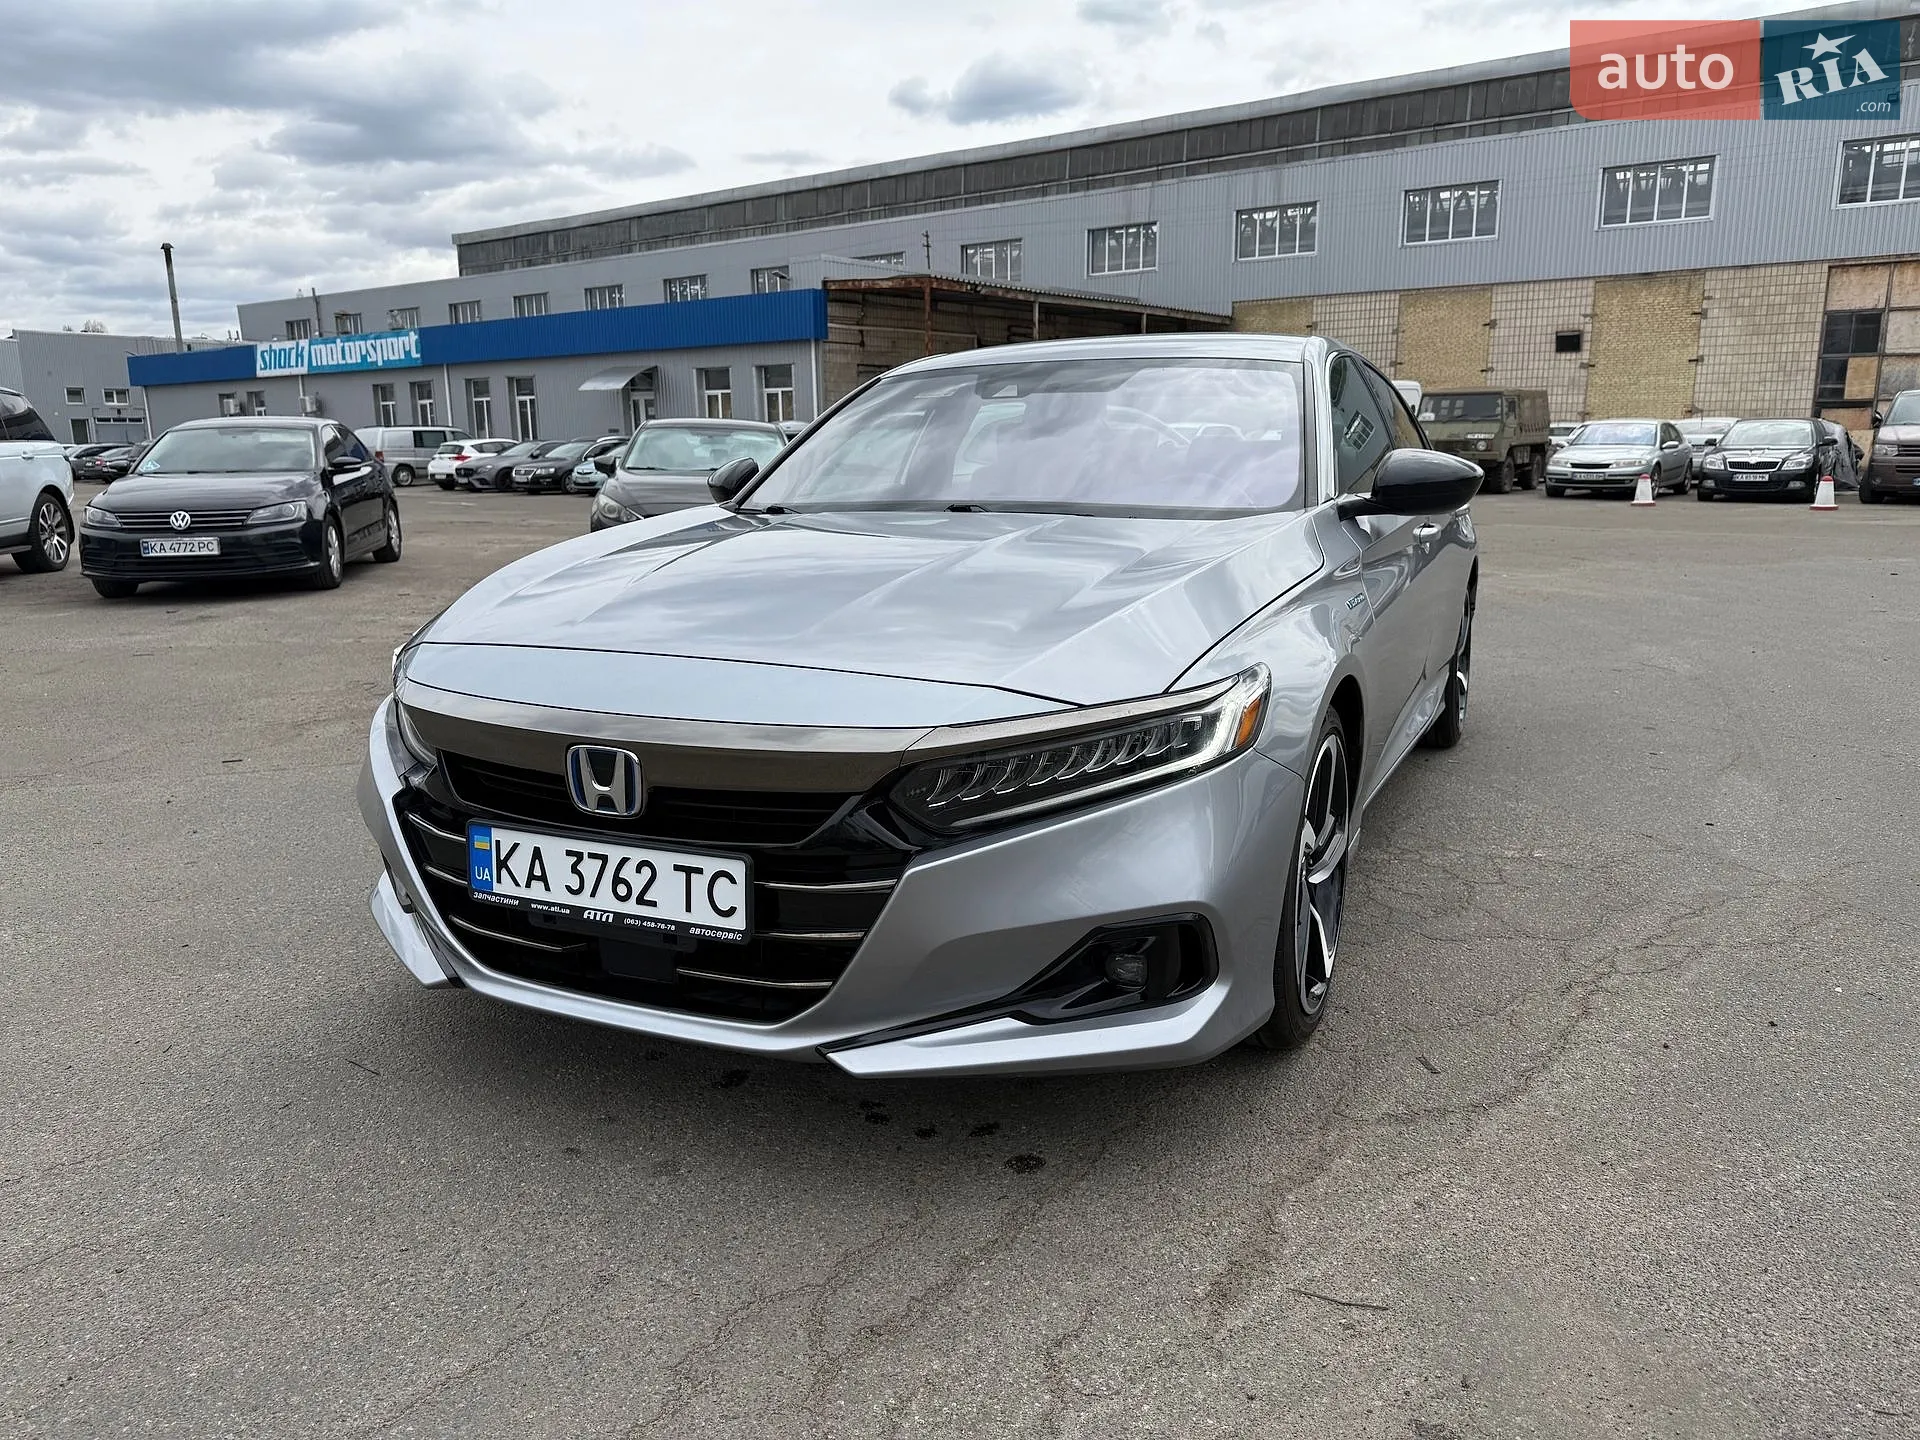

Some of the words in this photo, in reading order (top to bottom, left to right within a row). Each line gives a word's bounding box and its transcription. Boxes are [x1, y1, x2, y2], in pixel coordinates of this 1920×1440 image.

[259, 342, 306, 371] shock
[311, 330, 421, 367] motorsport
[149, 542, 167, 554] KA
[169, 541, 196, 553] 4772
[198, 541, 215, 553] PC
[474, 865, 491, 882] UA
[494, 839, 551, 892] KA
[564, 849, 658, 907] 3762
[672, 863, 738, 918] TC
[473, 891, 519, 906] запчастини
[623, 917, 642, 927] (063)
[689, 925, 743, 941] автосервіс
